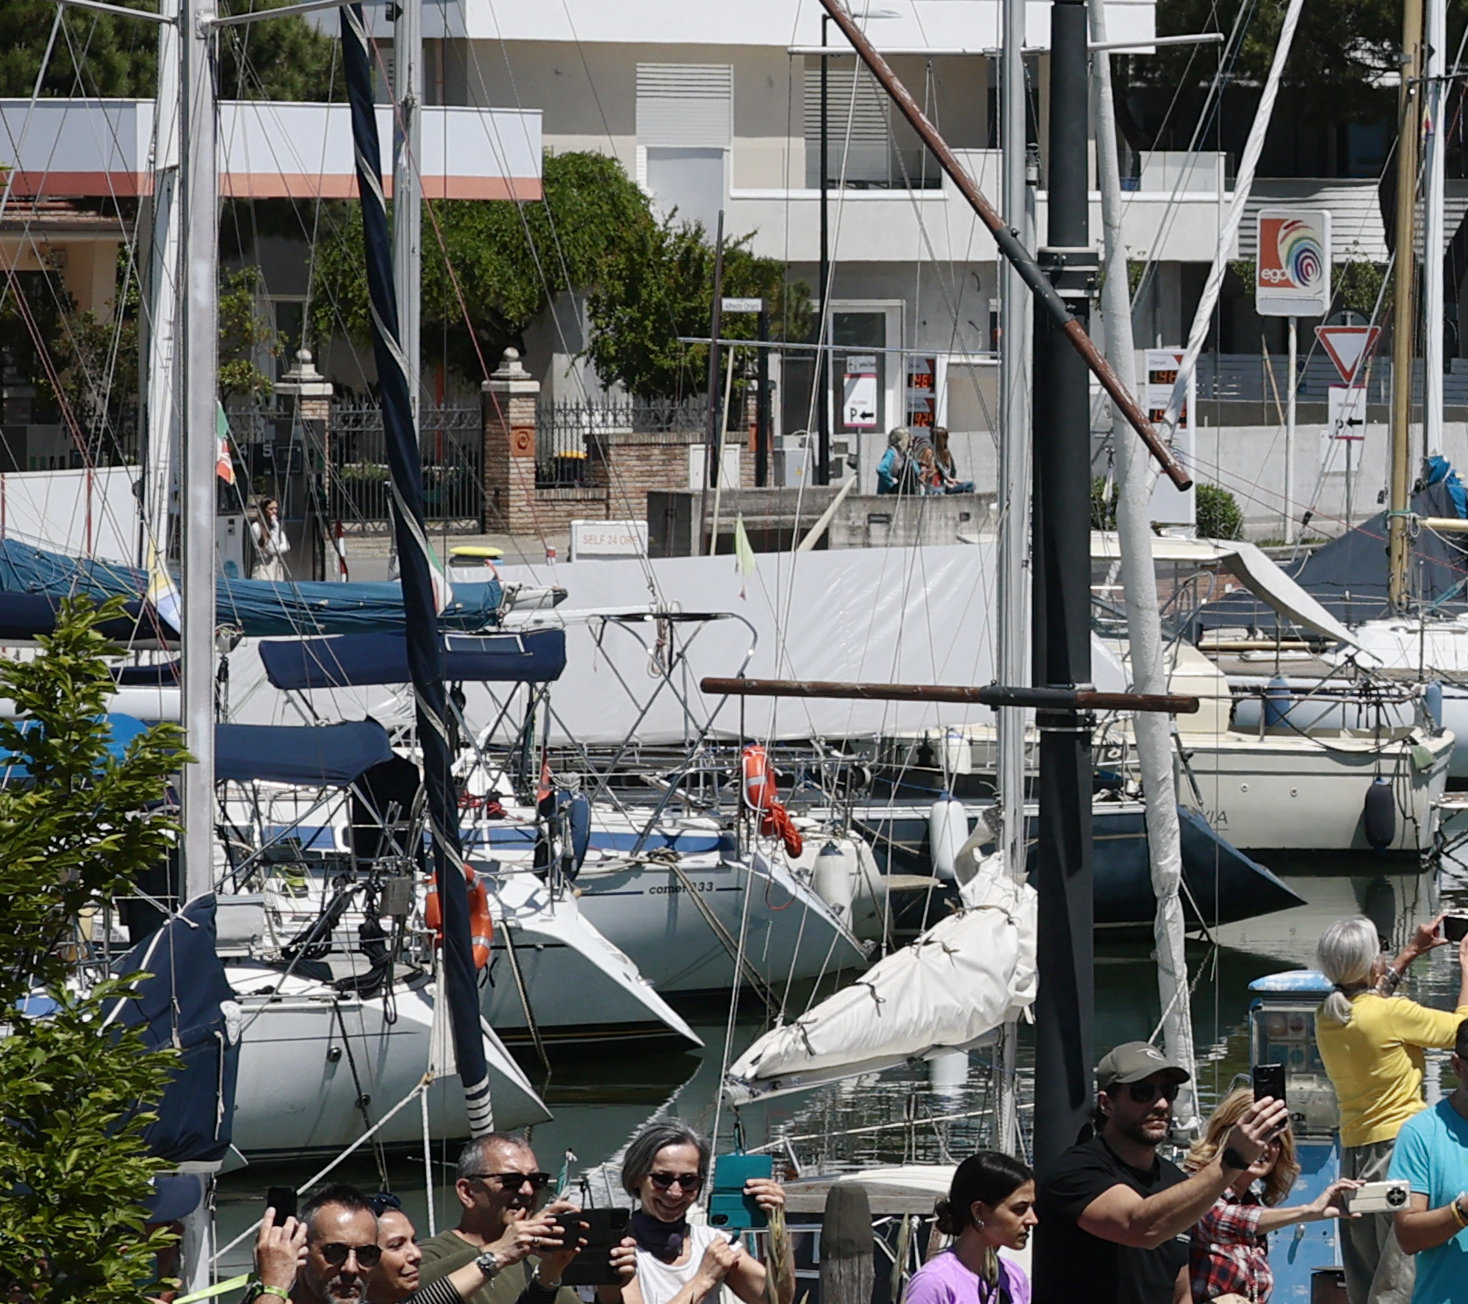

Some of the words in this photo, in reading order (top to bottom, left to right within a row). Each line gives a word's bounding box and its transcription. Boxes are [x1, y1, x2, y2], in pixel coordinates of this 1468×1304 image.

[1261, 268, 1288, 284] ego
[582, 535, 606, 545] SELF
[607, 535, 618, 545] 24
